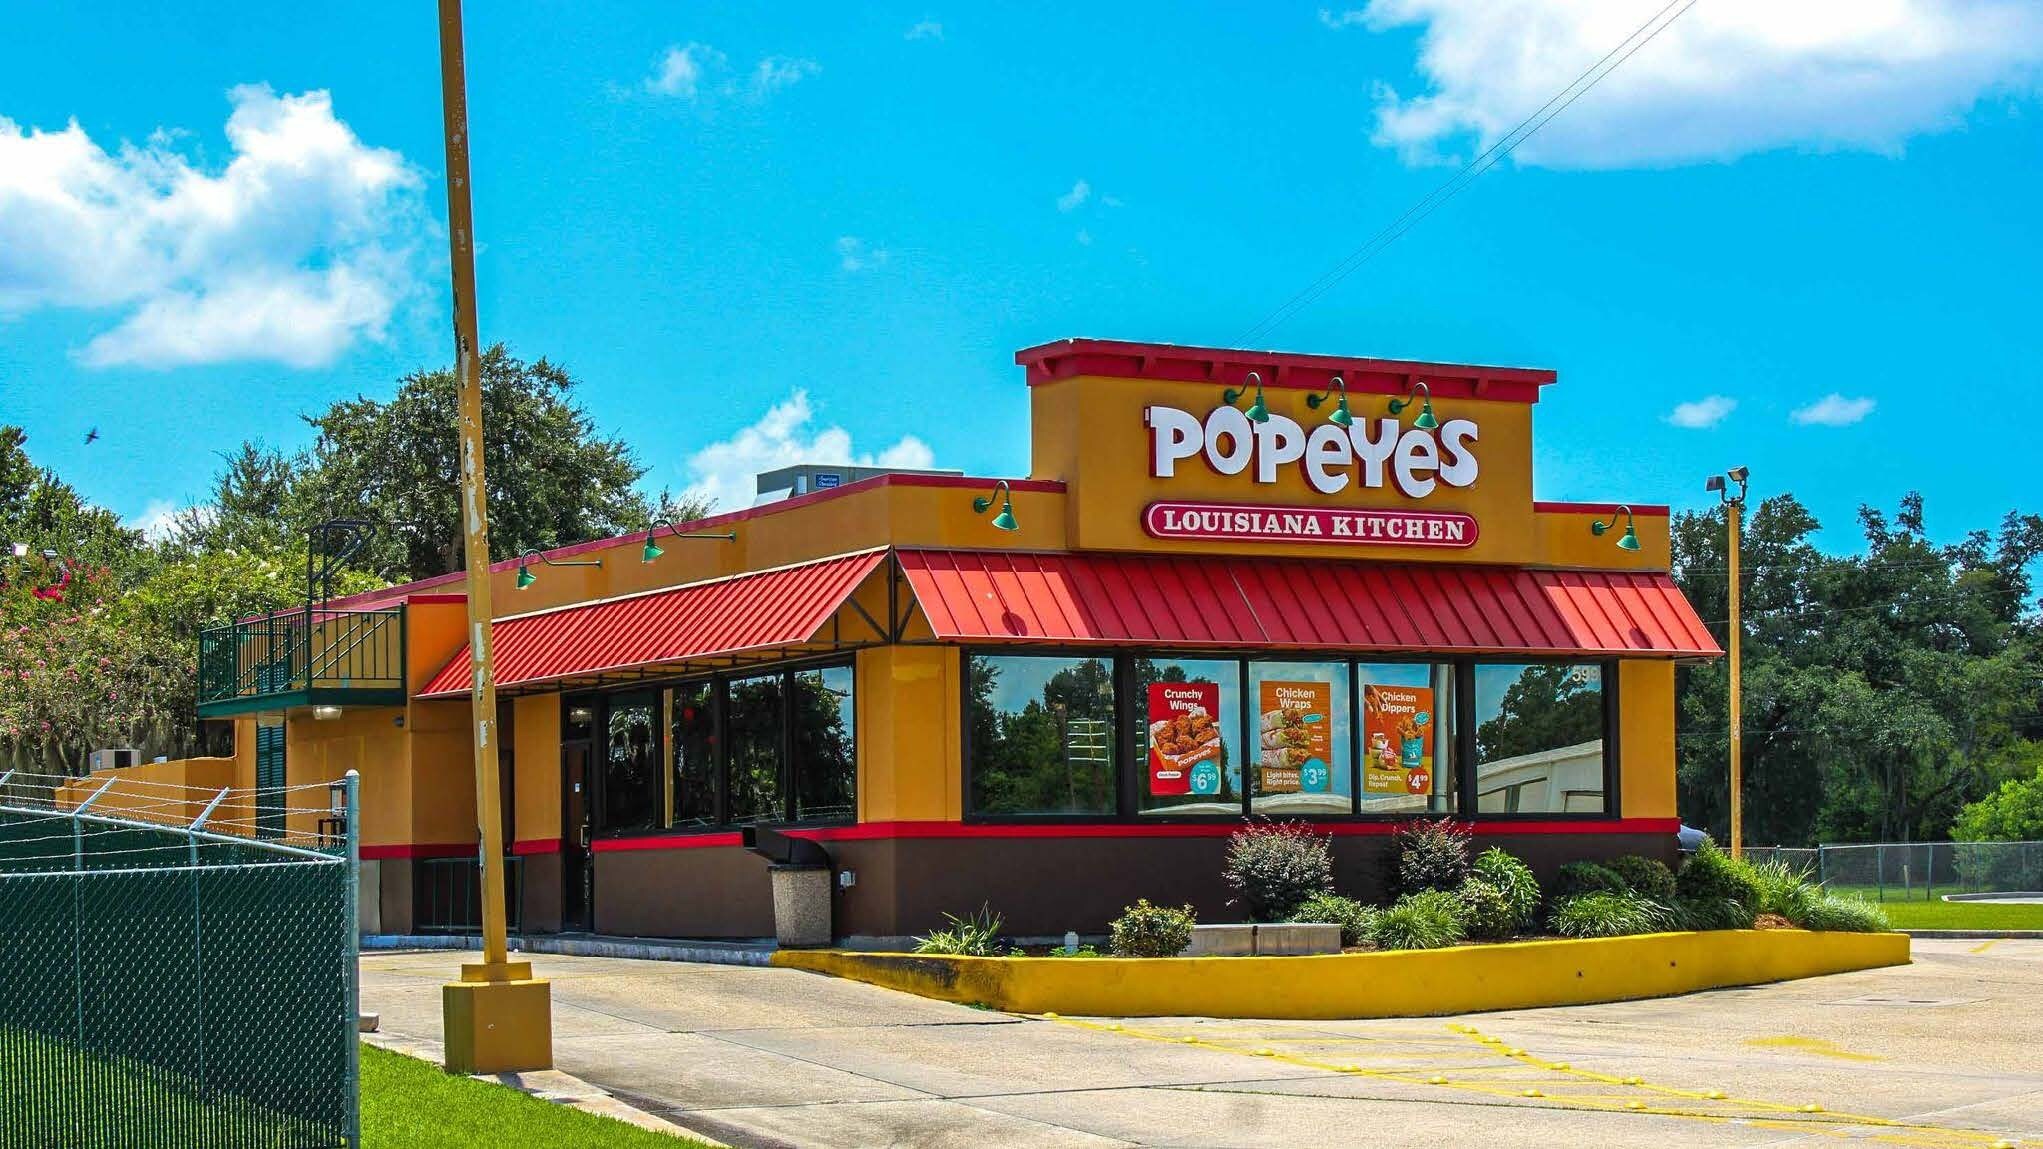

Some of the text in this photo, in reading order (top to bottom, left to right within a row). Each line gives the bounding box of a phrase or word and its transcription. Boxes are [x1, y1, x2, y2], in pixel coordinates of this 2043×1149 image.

[1163, 510, 1465, 541] LOUISIANA KITCHEN
[1164, 689, 1203, 700] Crunchy
[1275, 687, 1315, 699] Chicken
[1381, 691, 1417, 703] Chicken
[1170, 700, 1198, 711] Wings
[1280, 699, 1312, 710] Wraps
[1381, 703, 1416, 714] Dippers
[1266, 771, 1282, 779] Light
[1266, 778, 1282, 786] Right
